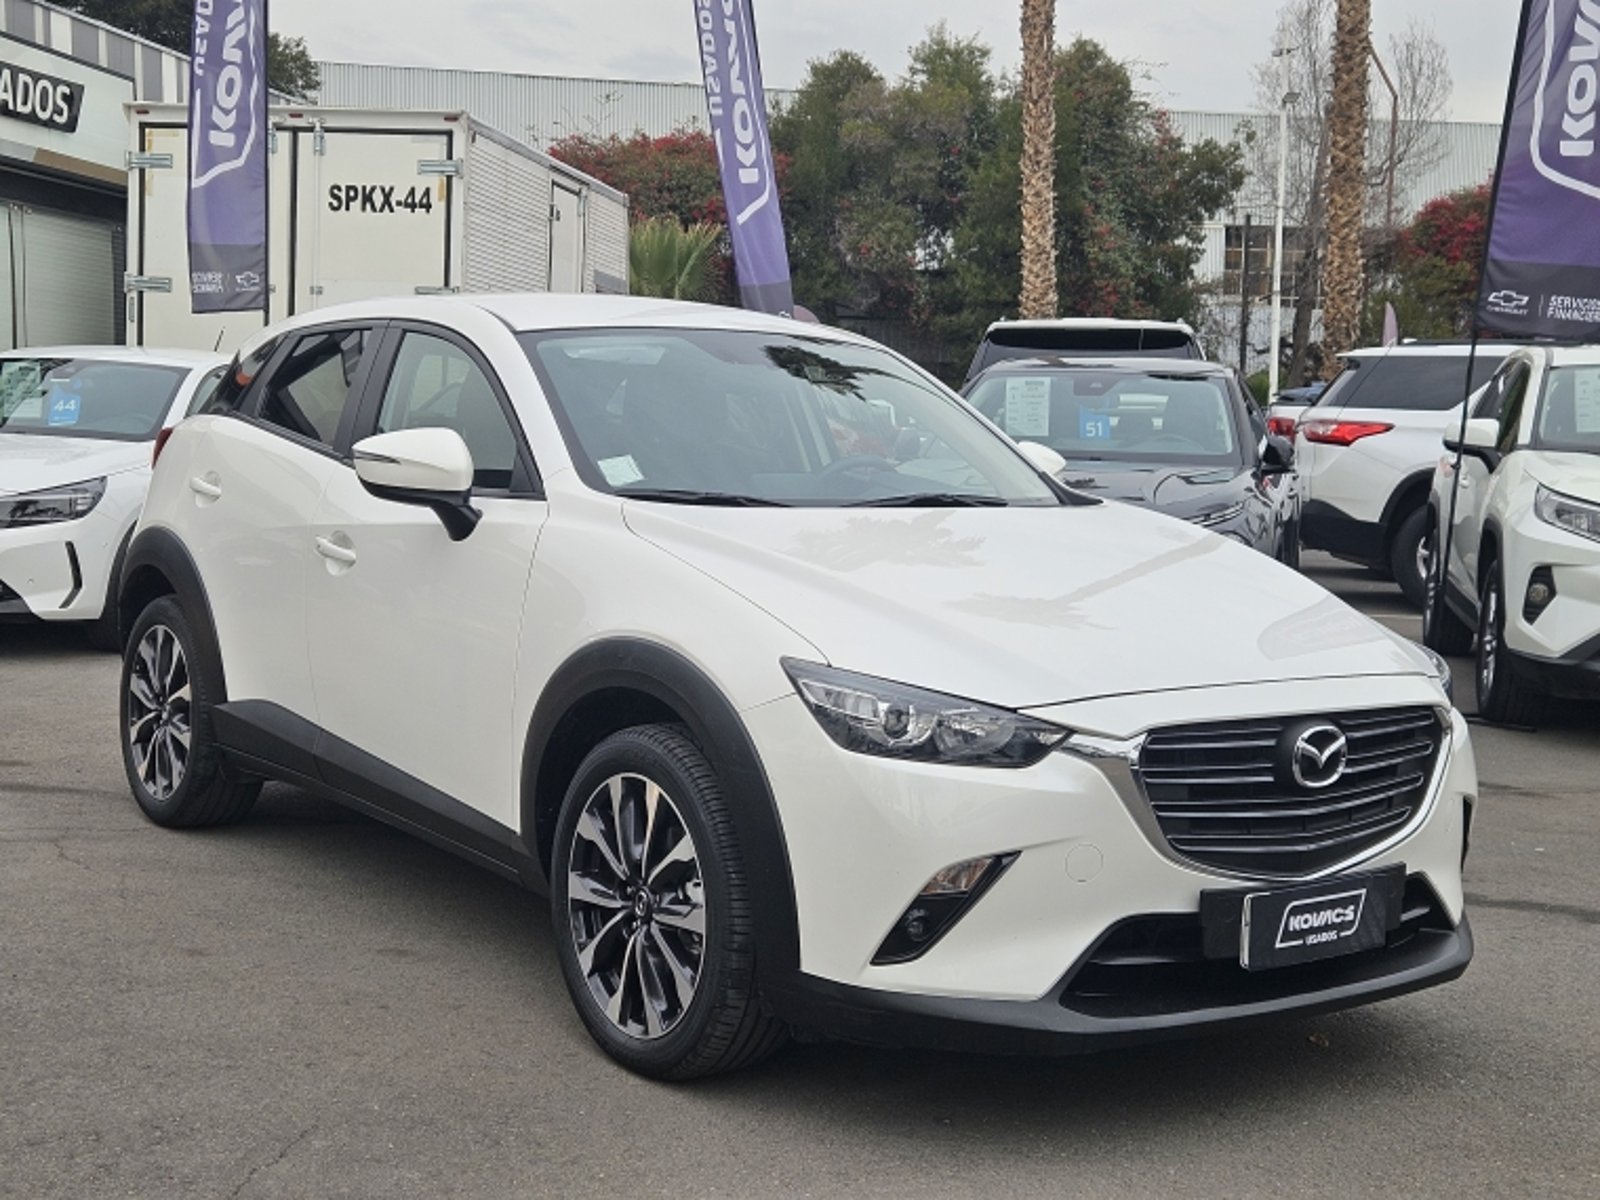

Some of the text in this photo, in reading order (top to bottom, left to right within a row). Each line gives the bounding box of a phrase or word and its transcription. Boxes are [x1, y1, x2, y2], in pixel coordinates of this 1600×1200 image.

[0, 68, 70, 124] ADOS
[328, 183, 432, 214] SPKX-44
[54, 399, 77, 411] 44
[1086, 421, 1102, 437] 51
[1288, 904, 1355, 931] KOVACS
